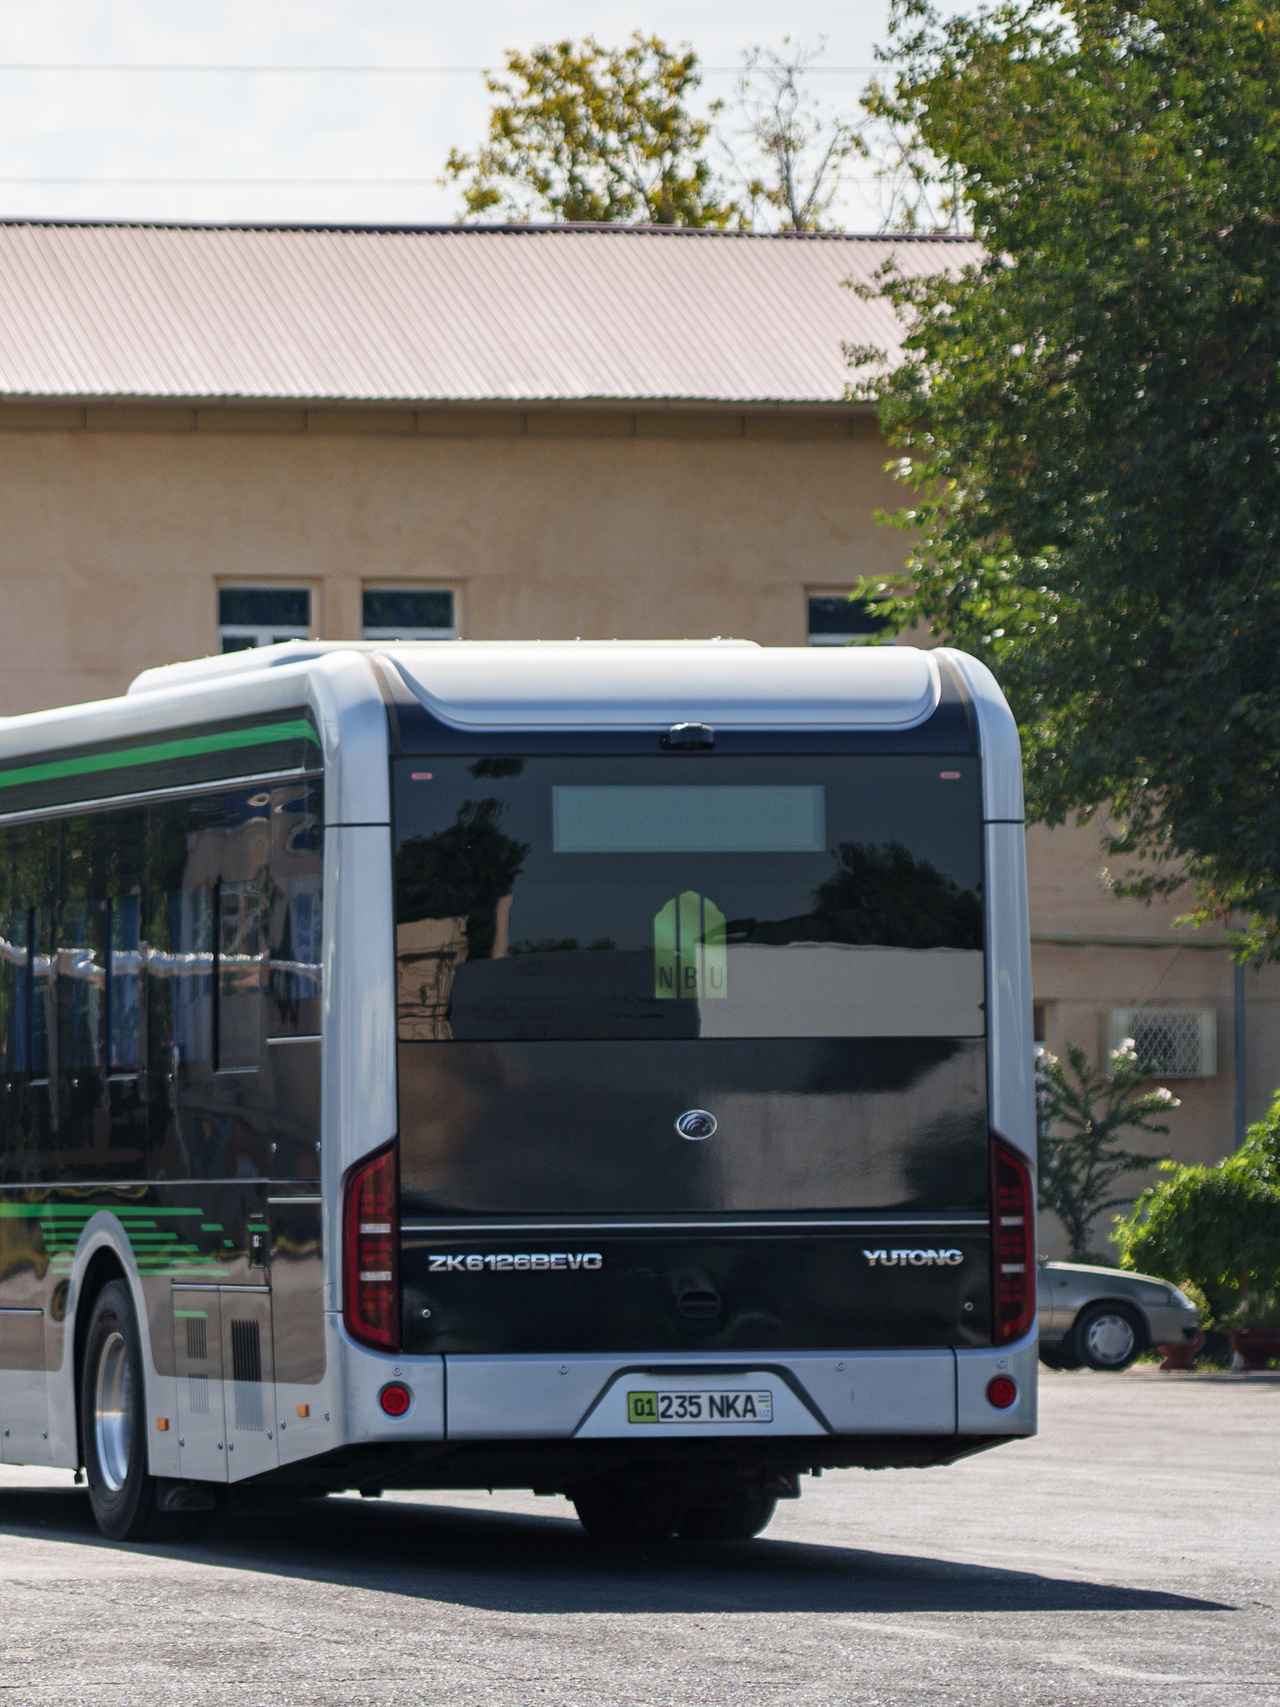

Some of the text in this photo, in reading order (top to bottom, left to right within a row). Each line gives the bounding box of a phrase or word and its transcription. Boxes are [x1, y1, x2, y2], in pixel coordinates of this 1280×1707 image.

[660, 966, 724, 989] NBU
[863, 1249, 964, 1266] YUTONG
[634, 1398, 656, 1416] 01
[660, 1395, 702, 1418] 235
[709, 1395, 757, 1418] NKA
